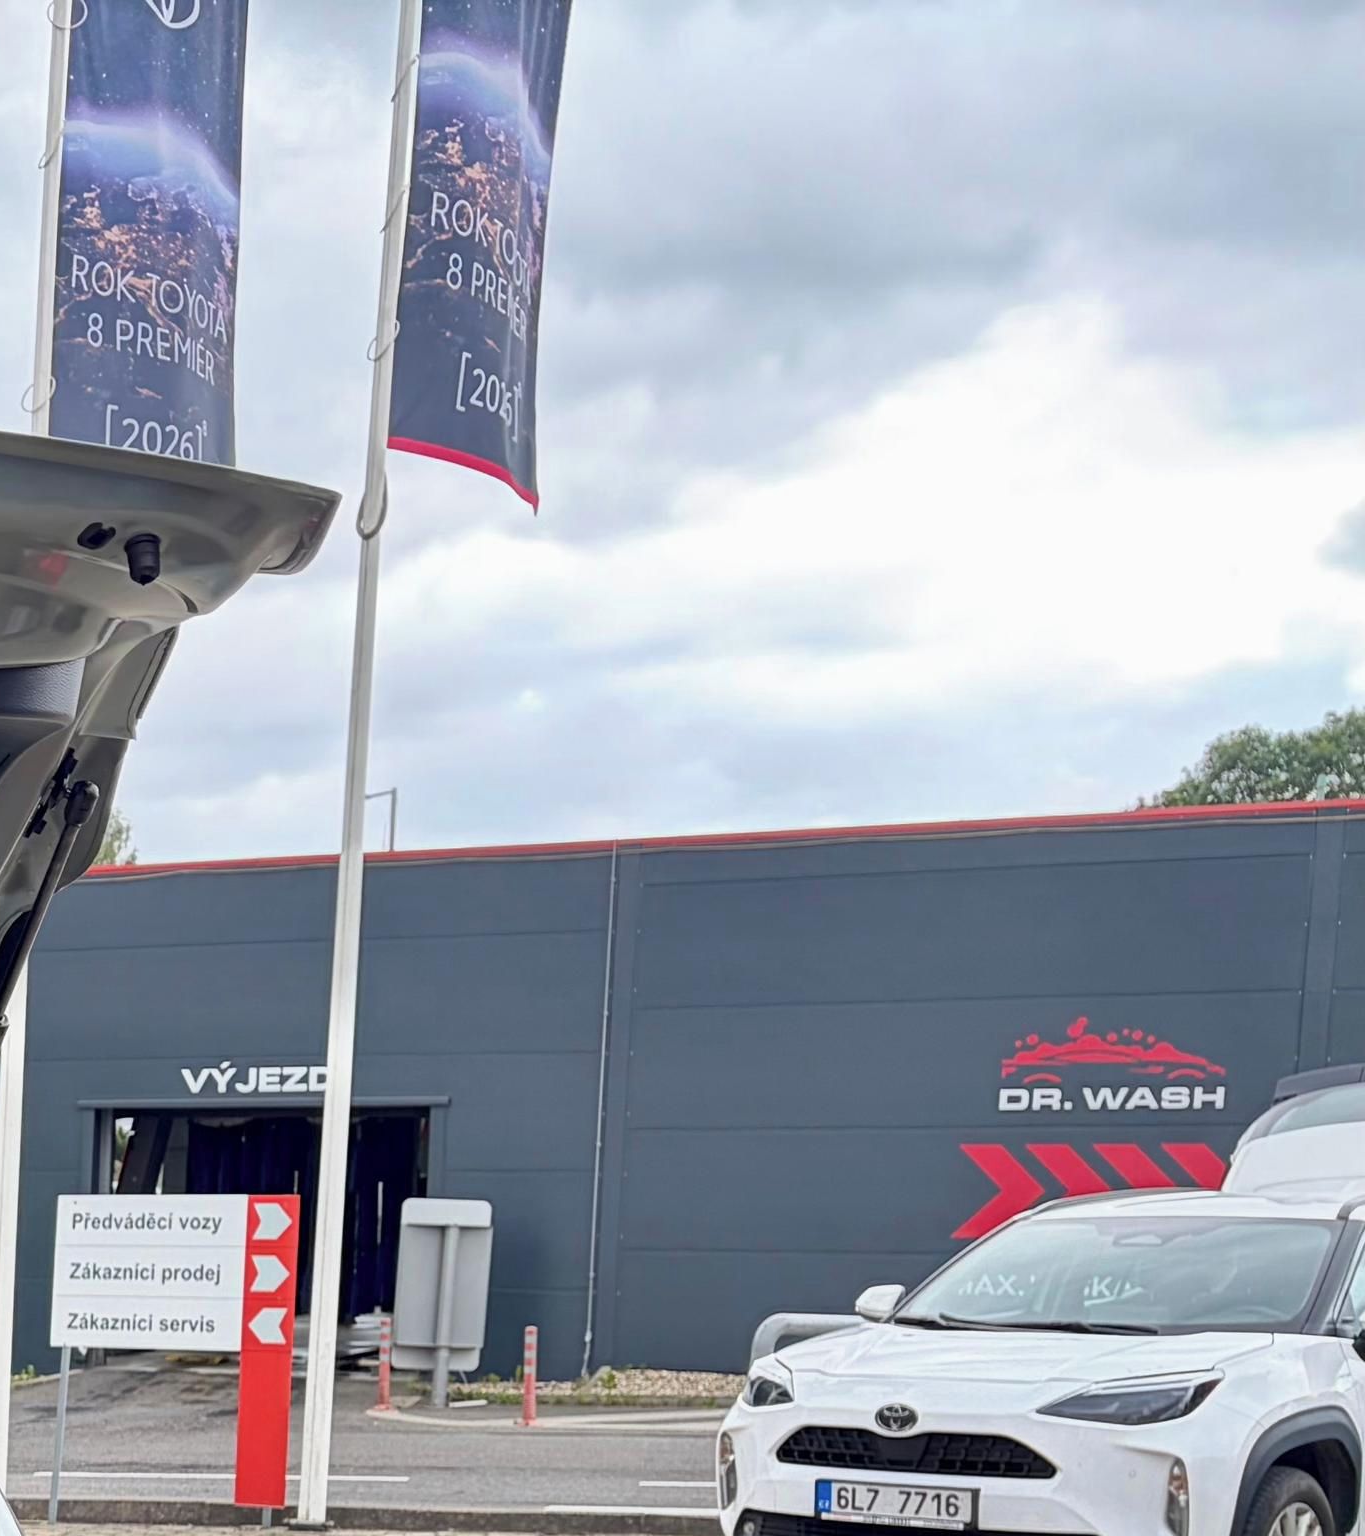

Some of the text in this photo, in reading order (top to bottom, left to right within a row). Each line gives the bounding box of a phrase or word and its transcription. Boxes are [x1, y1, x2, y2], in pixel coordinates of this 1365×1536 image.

[430, 191, 489, 248] ROK
[446, 253, 463, 290] 8
[71, 254, 228, 345] ROK TOYOTA
[87, 312, 215, 386] 8 PREMIÉR
[998, 1086, 1226, 1111] DR. WASH
[71, 1212, 223, 1235] Předváděcí vozy
[69, 1262, 222, 1286] Zákazníci prodej
[67, 1312, 216, 1333] Zákazníci servis
[836, 1486, 960, 1517] 6L7 7716
